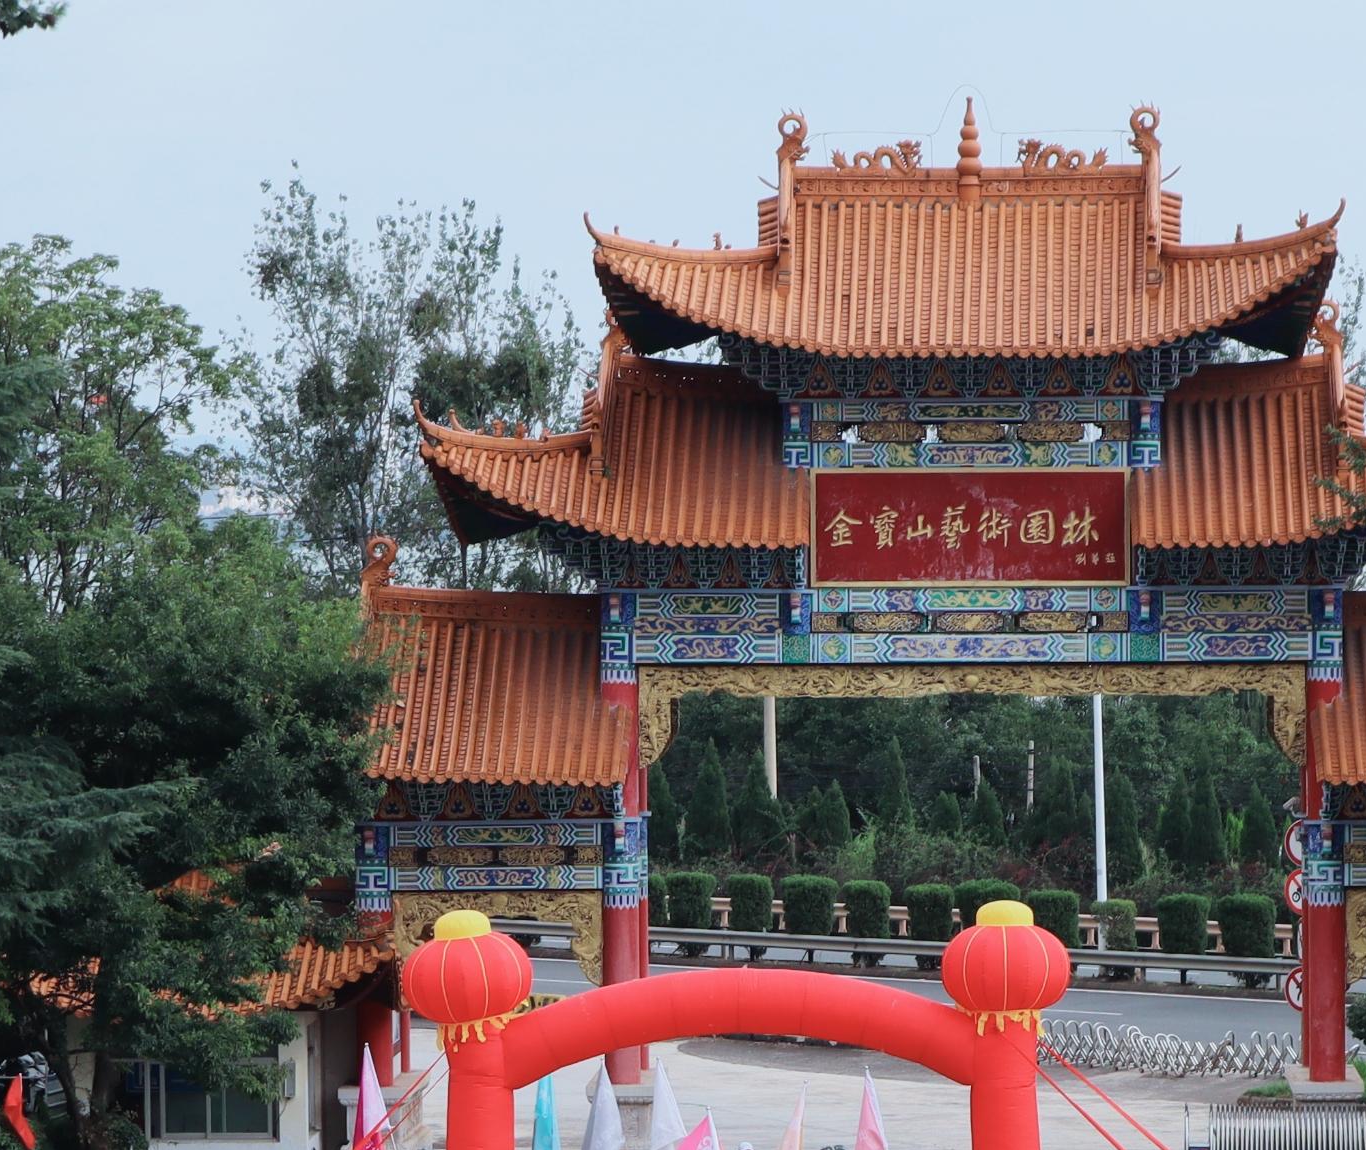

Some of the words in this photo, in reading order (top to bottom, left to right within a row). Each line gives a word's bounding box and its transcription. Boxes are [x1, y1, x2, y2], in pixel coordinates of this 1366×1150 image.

[823, 505, 1101, 551] 金寶山藝術園林
